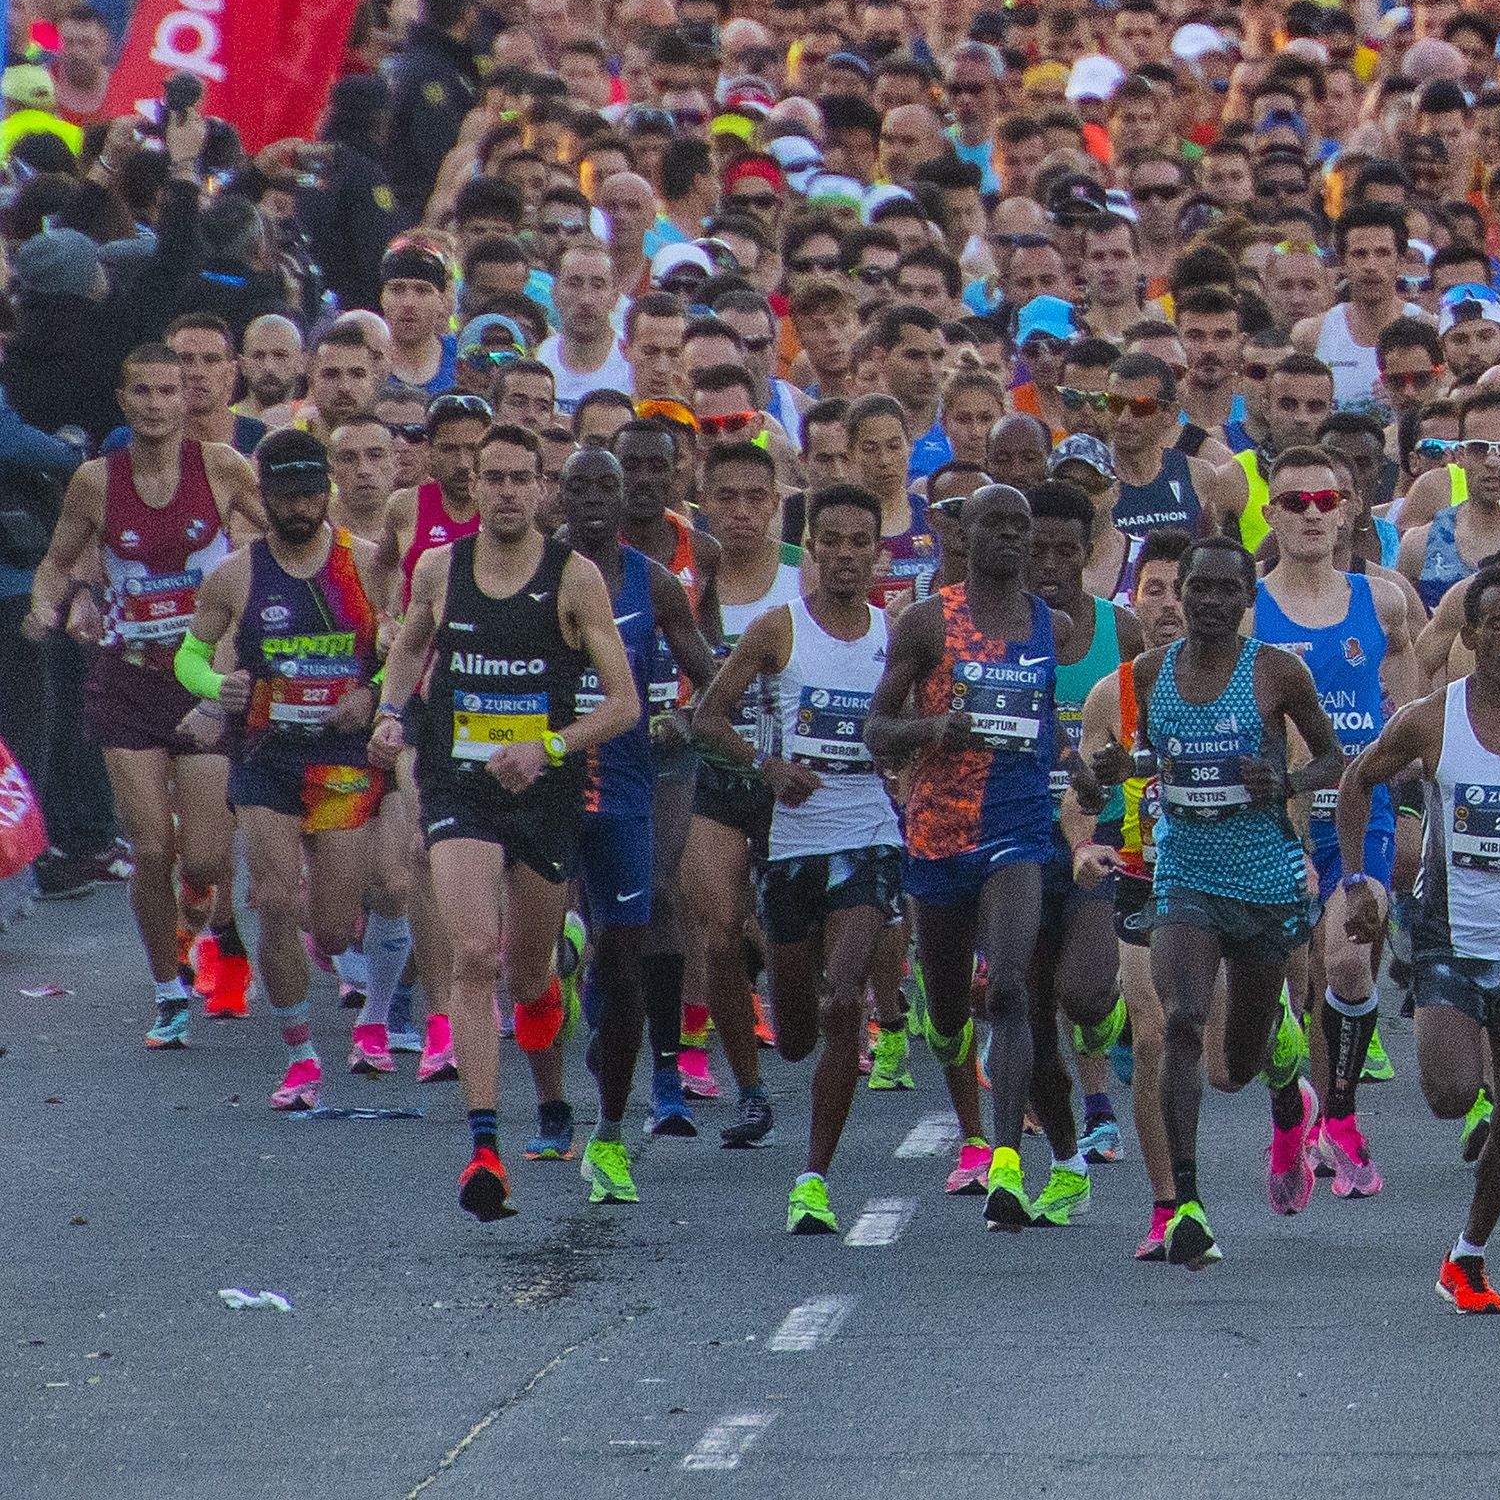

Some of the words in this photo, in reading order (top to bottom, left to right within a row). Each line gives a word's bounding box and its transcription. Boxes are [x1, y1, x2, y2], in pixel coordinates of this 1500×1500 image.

[1116, 509, 1188, 528] MARATHON
[141, 572, 197, 599] ZURICH
[301, 661, 350, 675] ZURICH
[451, 652, 545, 676] Alimco
[985, 667, 1038, 683] ZURICH
[484, 699, 538, 711] ZURICH
[832, 695, 873, 710] ZURIC
[995, 695, 1006, 709] 5
[835, 720, 856, 736] 26
[977, 719, 1018, 732] KIPTUM
[1185, 739, 1240, 754] ZURICH
[1190, 766, 1221, 781] 362
